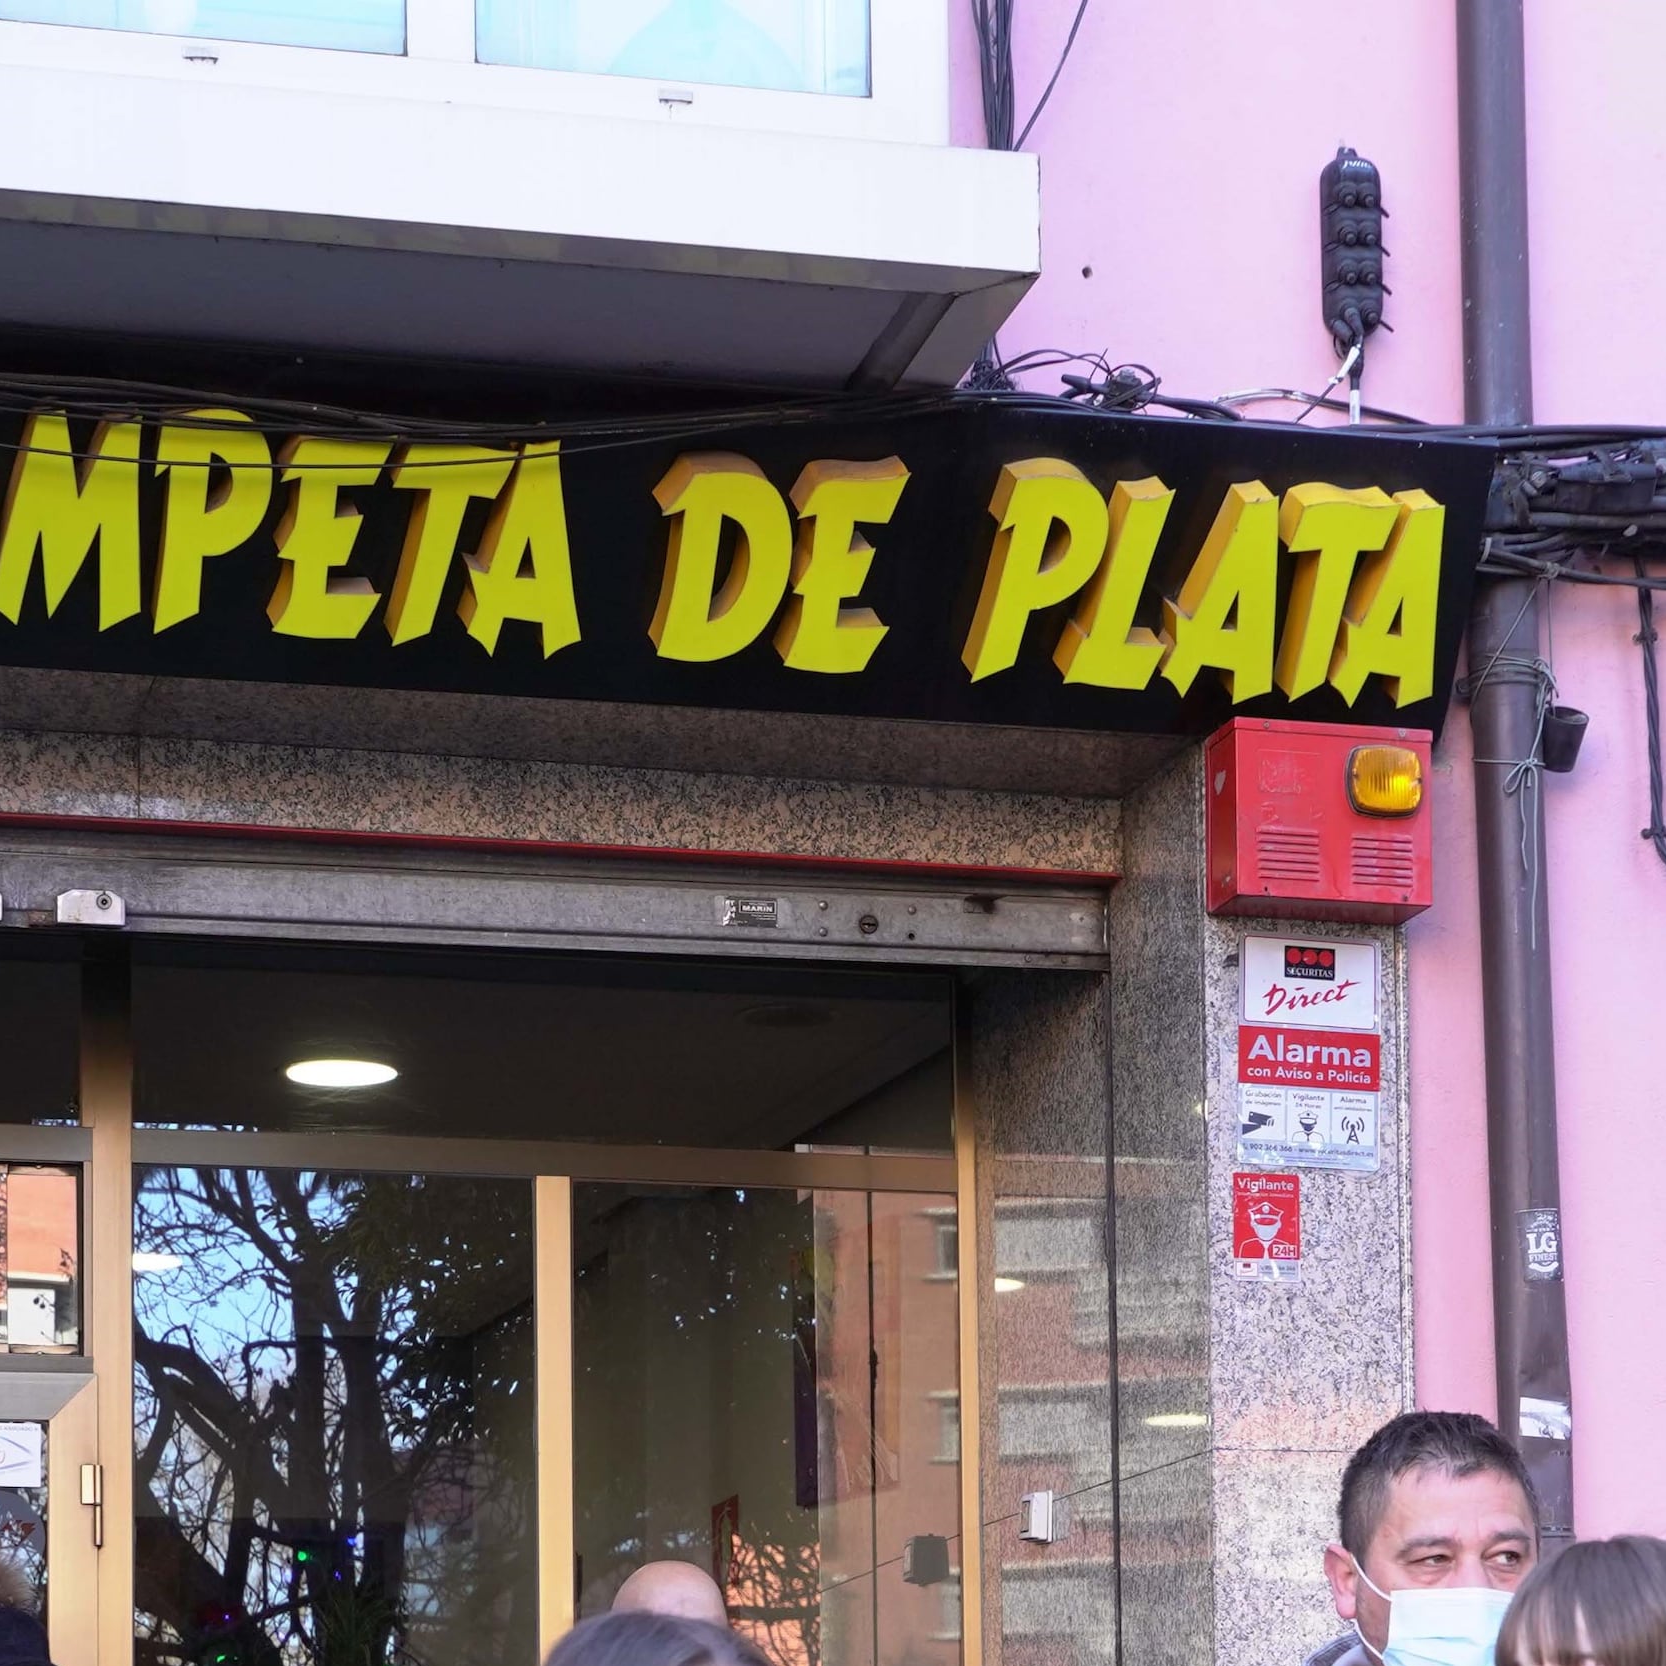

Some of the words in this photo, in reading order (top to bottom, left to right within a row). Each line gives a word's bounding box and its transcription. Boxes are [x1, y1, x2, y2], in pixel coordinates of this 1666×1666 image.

[649, 452, 911, 673] DE
[961, 457, 1445, 709] PLATA
[1286, 966, 1333, 978] SECURITAS
[1262, 979, 1361, 1016] Direct
[1247, 1034, 1372, 1068] Alarma
[1247, 1067, 1271, 1077] con
[1275, 1067, 1312, 1080] Aviso
[1316, 1072, 1324, 1080] a
[1328, 1069, 1371, 1084] Policía
[1293, 1093, 1325, 1102] Vigilante
[1340, 1096, 1367, 1105] Alarma
[1237, 1178, 1295, 1193] Vigilante
[1274, 1246, 1296, 1257] 24H
